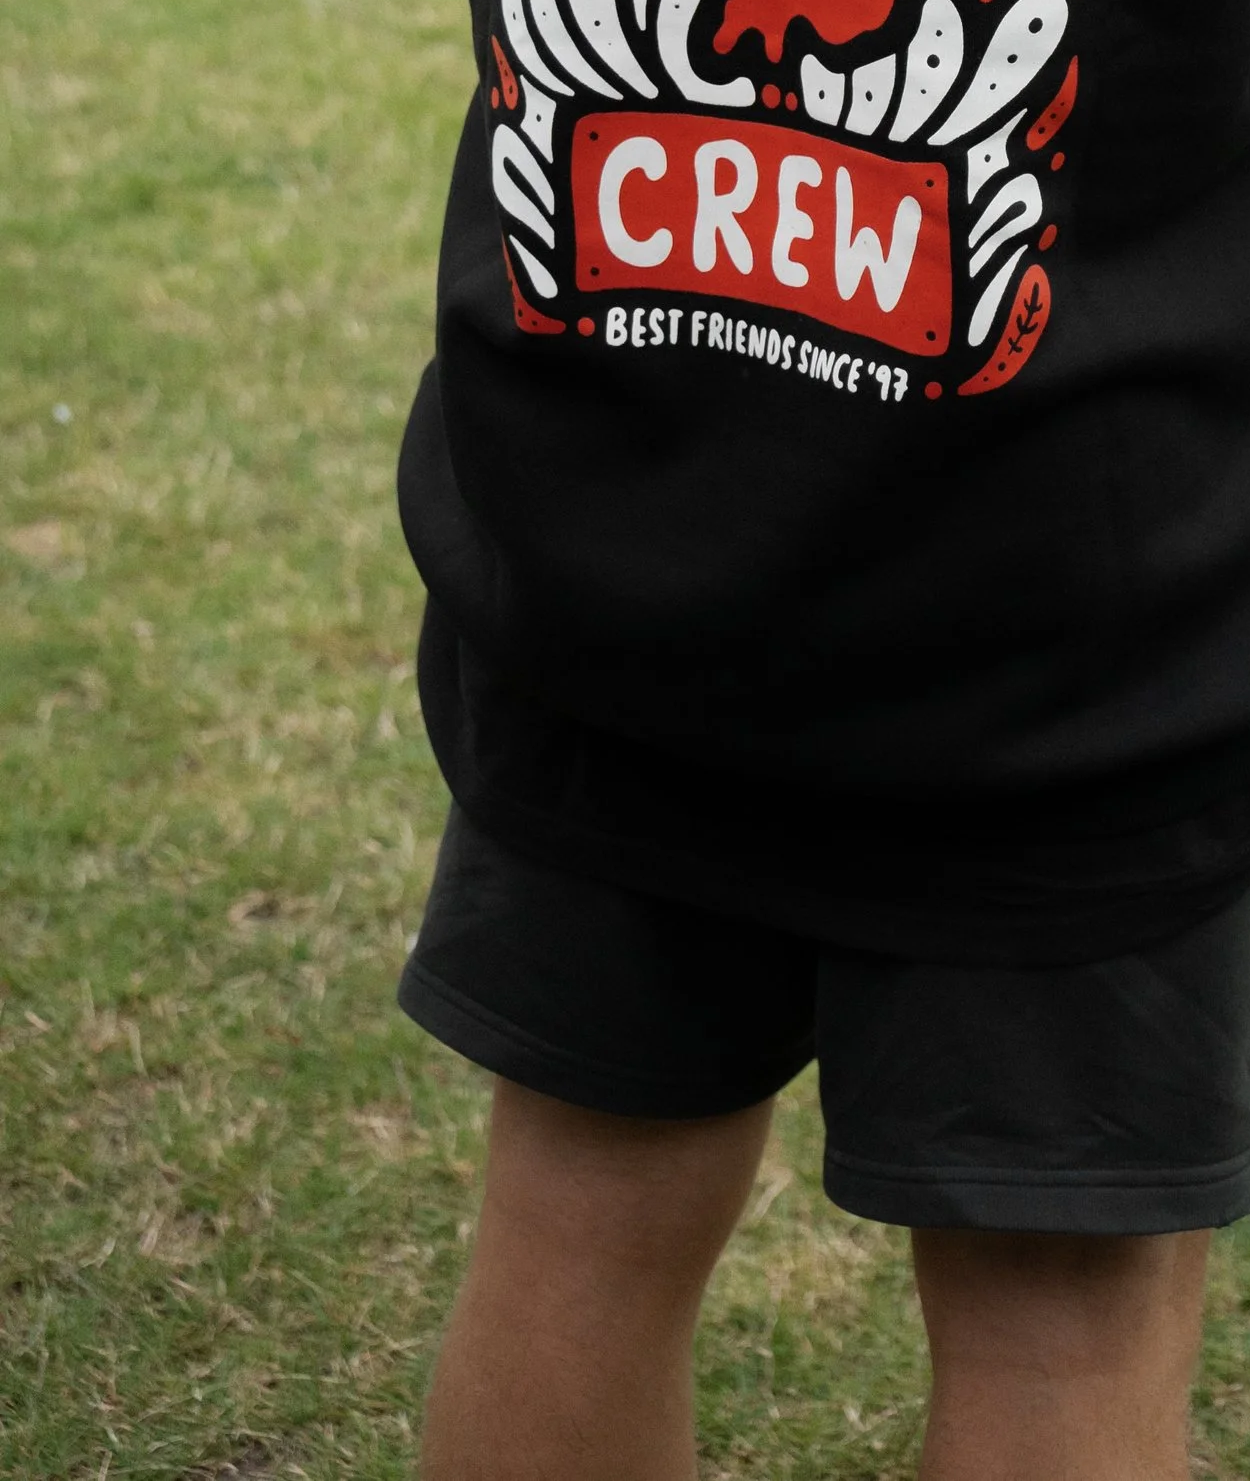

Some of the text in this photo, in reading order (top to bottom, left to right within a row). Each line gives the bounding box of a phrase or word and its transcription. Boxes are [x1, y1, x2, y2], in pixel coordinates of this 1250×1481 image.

[598, 136, 923, 313] CREW
[605, 306, 909, 402] BEST FRIENDS SINCE '97
